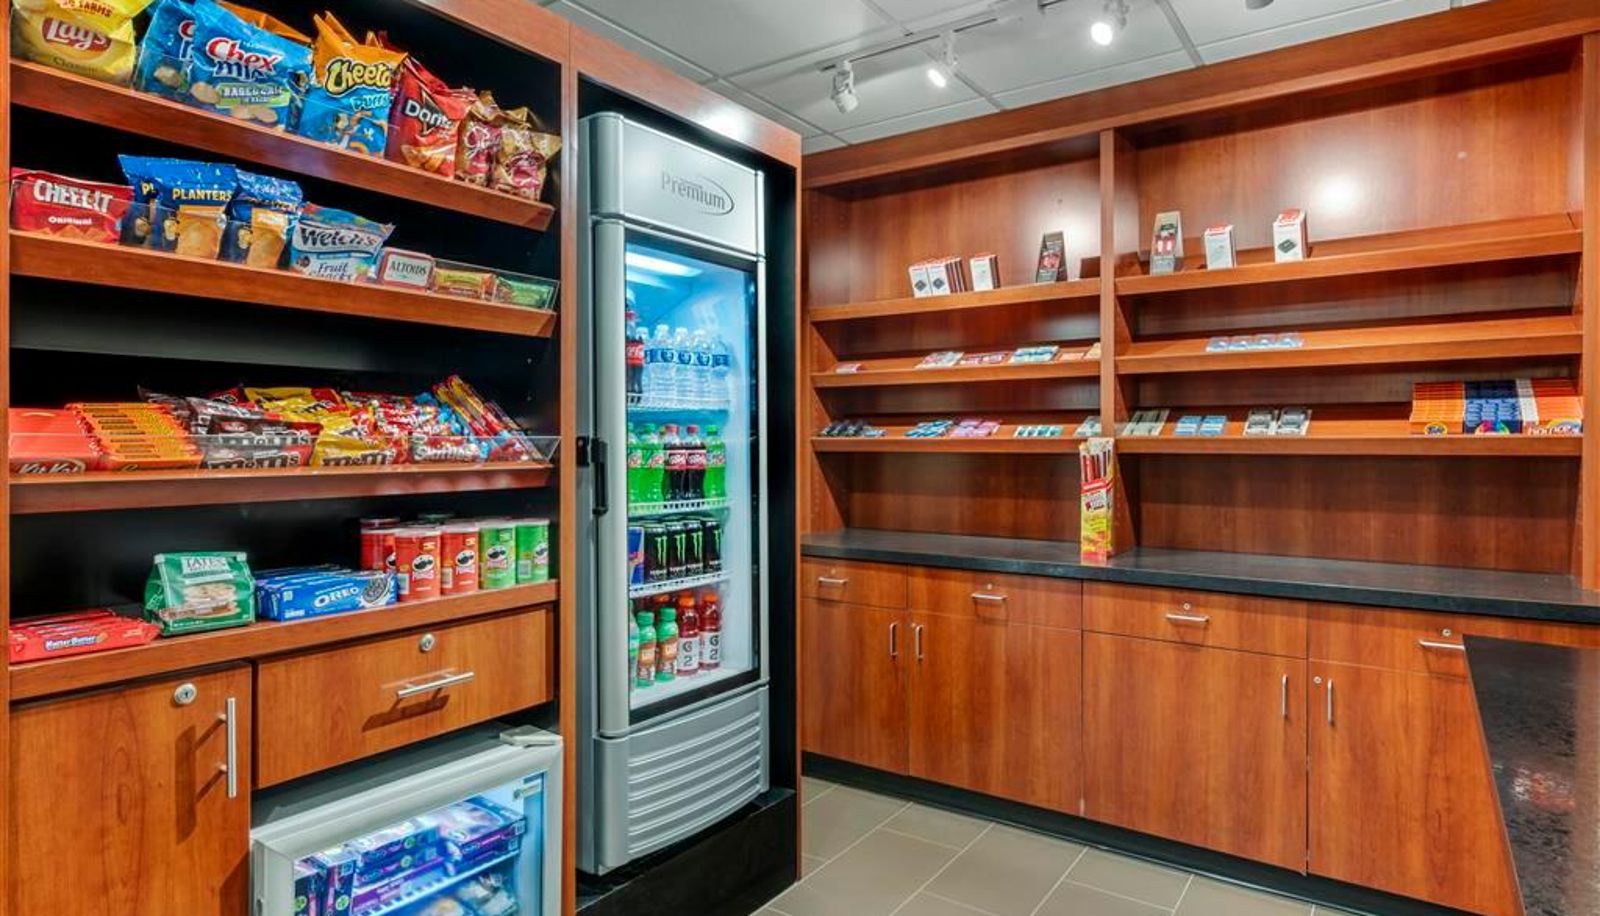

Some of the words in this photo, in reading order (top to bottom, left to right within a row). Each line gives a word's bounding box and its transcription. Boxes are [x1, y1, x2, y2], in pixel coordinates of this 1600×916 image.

[206, 37, 283, 72] Chex
[172, 188, 232, 202] PLANTERS
[661, 171, 726, 210] Premium
[300, 227, 378, 248] Welch's
[318, 261, 349, 273] Fruit
[390, 260, 427, 275] ALTOIDS
[313, 586, 359, 608] OREO
[683, 655, 693, 667] 2
